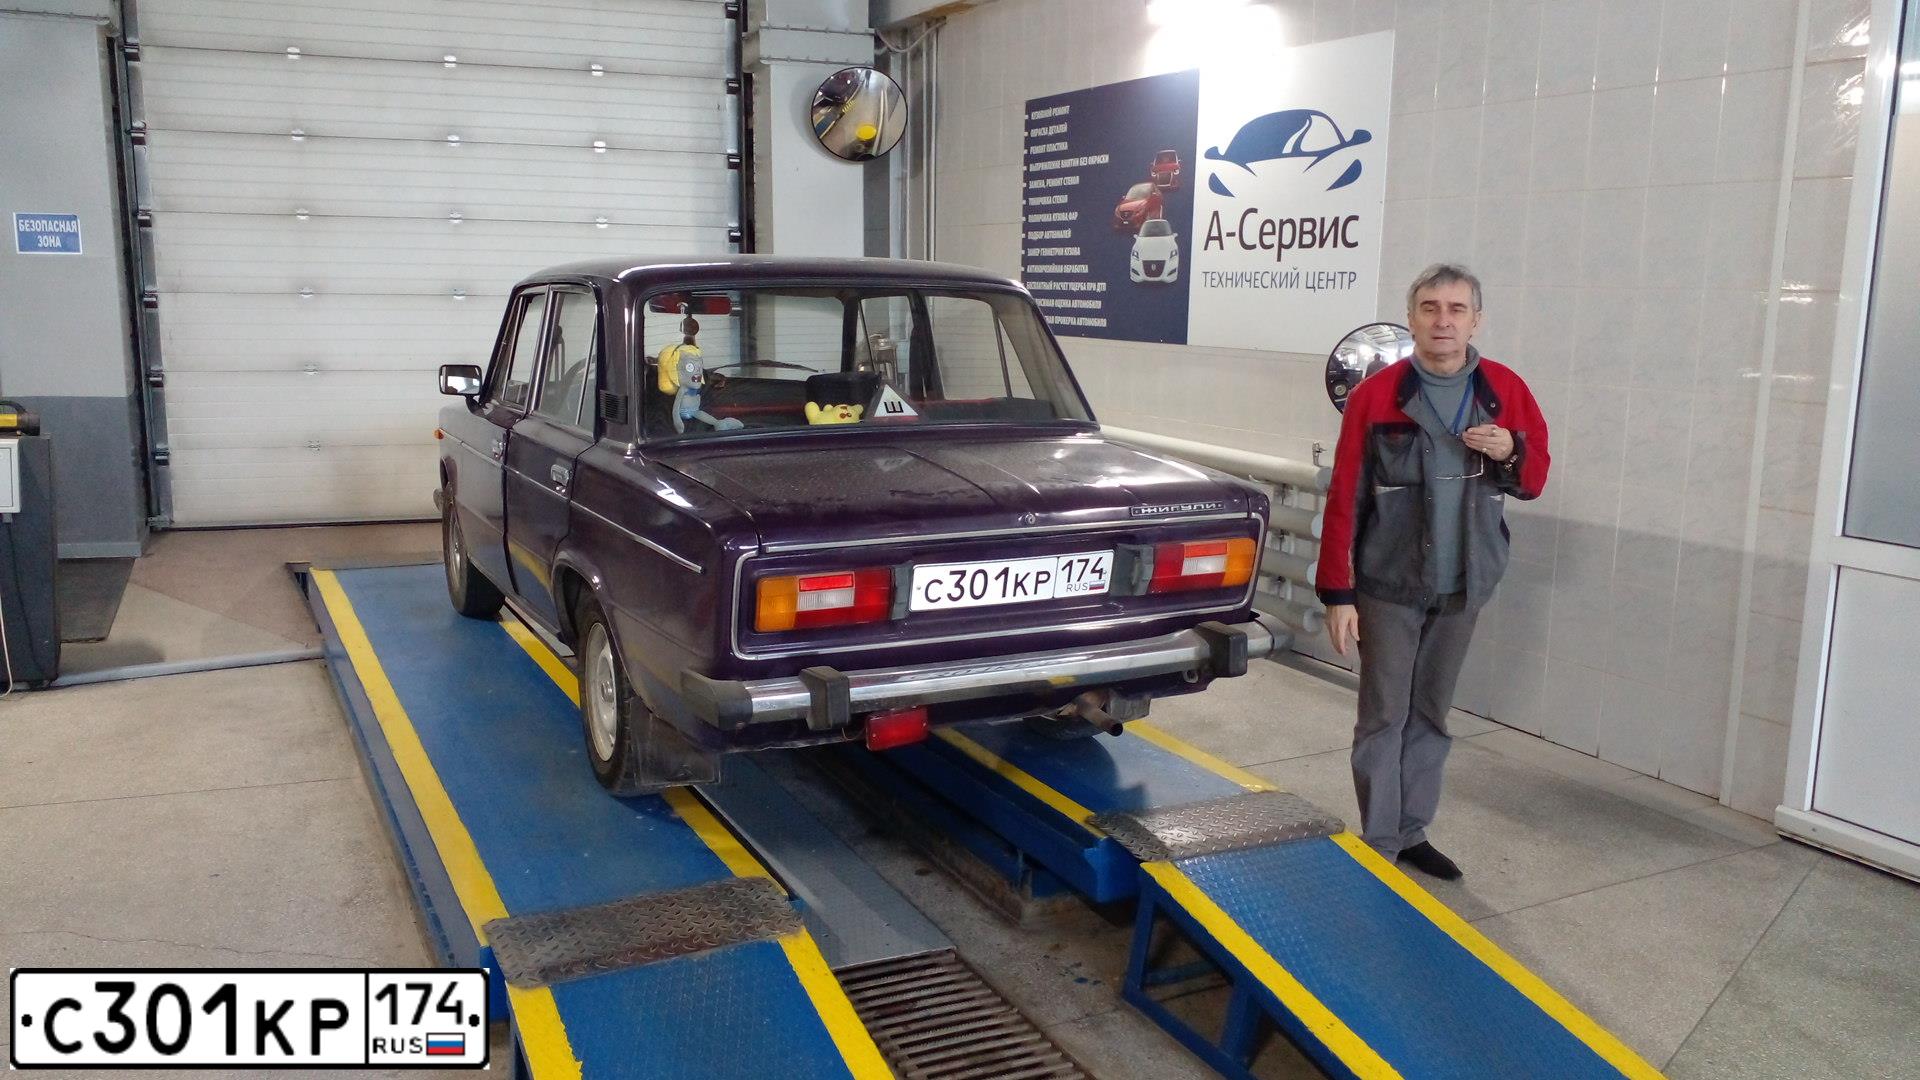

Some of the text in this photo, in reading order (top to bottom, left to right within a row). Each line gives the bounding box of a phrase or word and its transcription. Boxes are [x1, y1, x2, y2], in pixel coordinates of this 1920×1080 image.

[19, 220, 77, 232] БЕЗОПАСНАЯ
[1204, 208, 1359, 262] А-Сервис
[37, 236, 61, 247] ЗОНА
[1202, 267, 1357, 292] ТЕХНИЧЕСКИЙ ЦЕНТР
[884, 401, 904, 413] Ш
[1142, 503, 1216, 514] ЖИГУЛИ
[1062, 557, 1104, 583] 174
[1066, 582, 1088, 592] RUS
